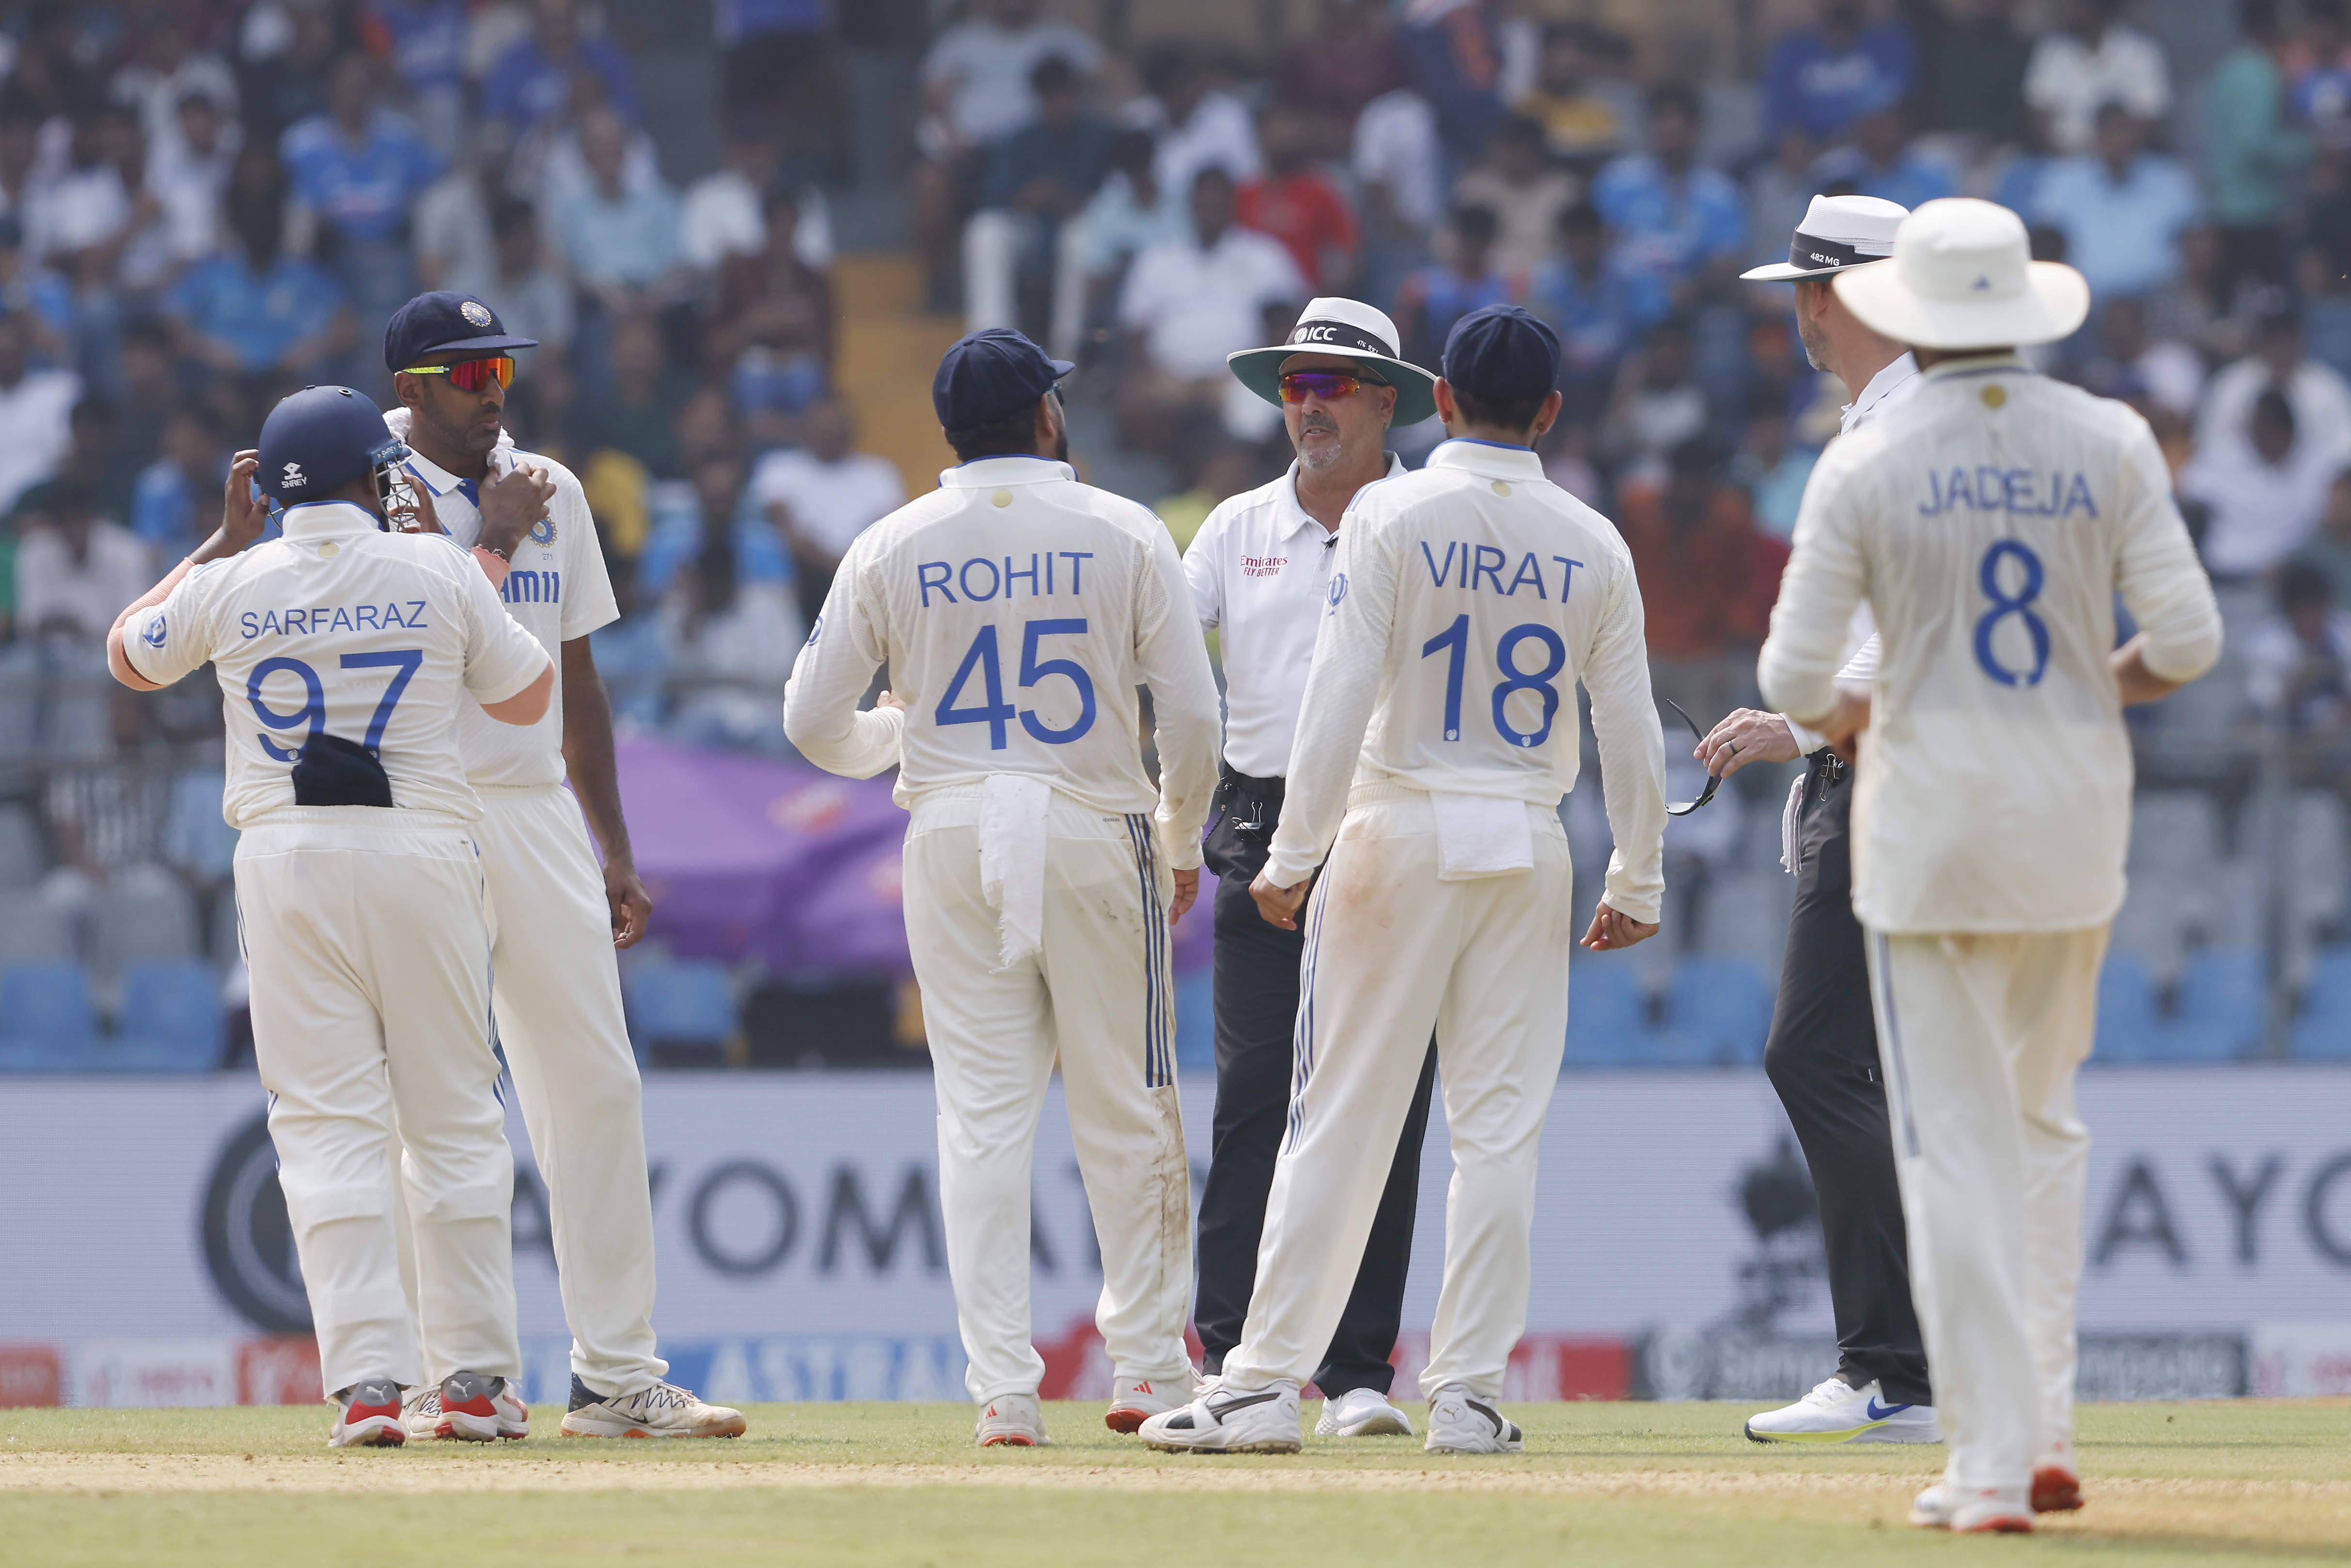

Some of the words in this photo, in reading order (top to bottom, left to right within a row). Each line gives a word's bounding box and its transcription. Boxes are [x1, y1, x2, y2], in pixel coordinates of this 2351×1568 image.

[1810, 252, 1824, 263] 482
[1825, 255, 1840, 266] MG
[1307, 327, 1337, 341] ICC
[1357, 339, 1366, 347] 476
[281, 476, 307, 488] SHREY
[1918, 464, 2099, 518] JADEJA
[918, 551, 1094, 608] ROHIT
[1240, 555, 1287, 567] Emirates
[1243, 567, 1256, 576] FLY
[1257, 567, 1280, 577] BETTER
[1420, 540, 1584, 603] VIRAT
[241, 600, 427, 639] SARFARAZ
[1972, 537, 2051, 689] 8
[935, 618, 1097, 751] 45
[1422, 613, 1566, 748] 18
[246, 649, 423, 762] 97
